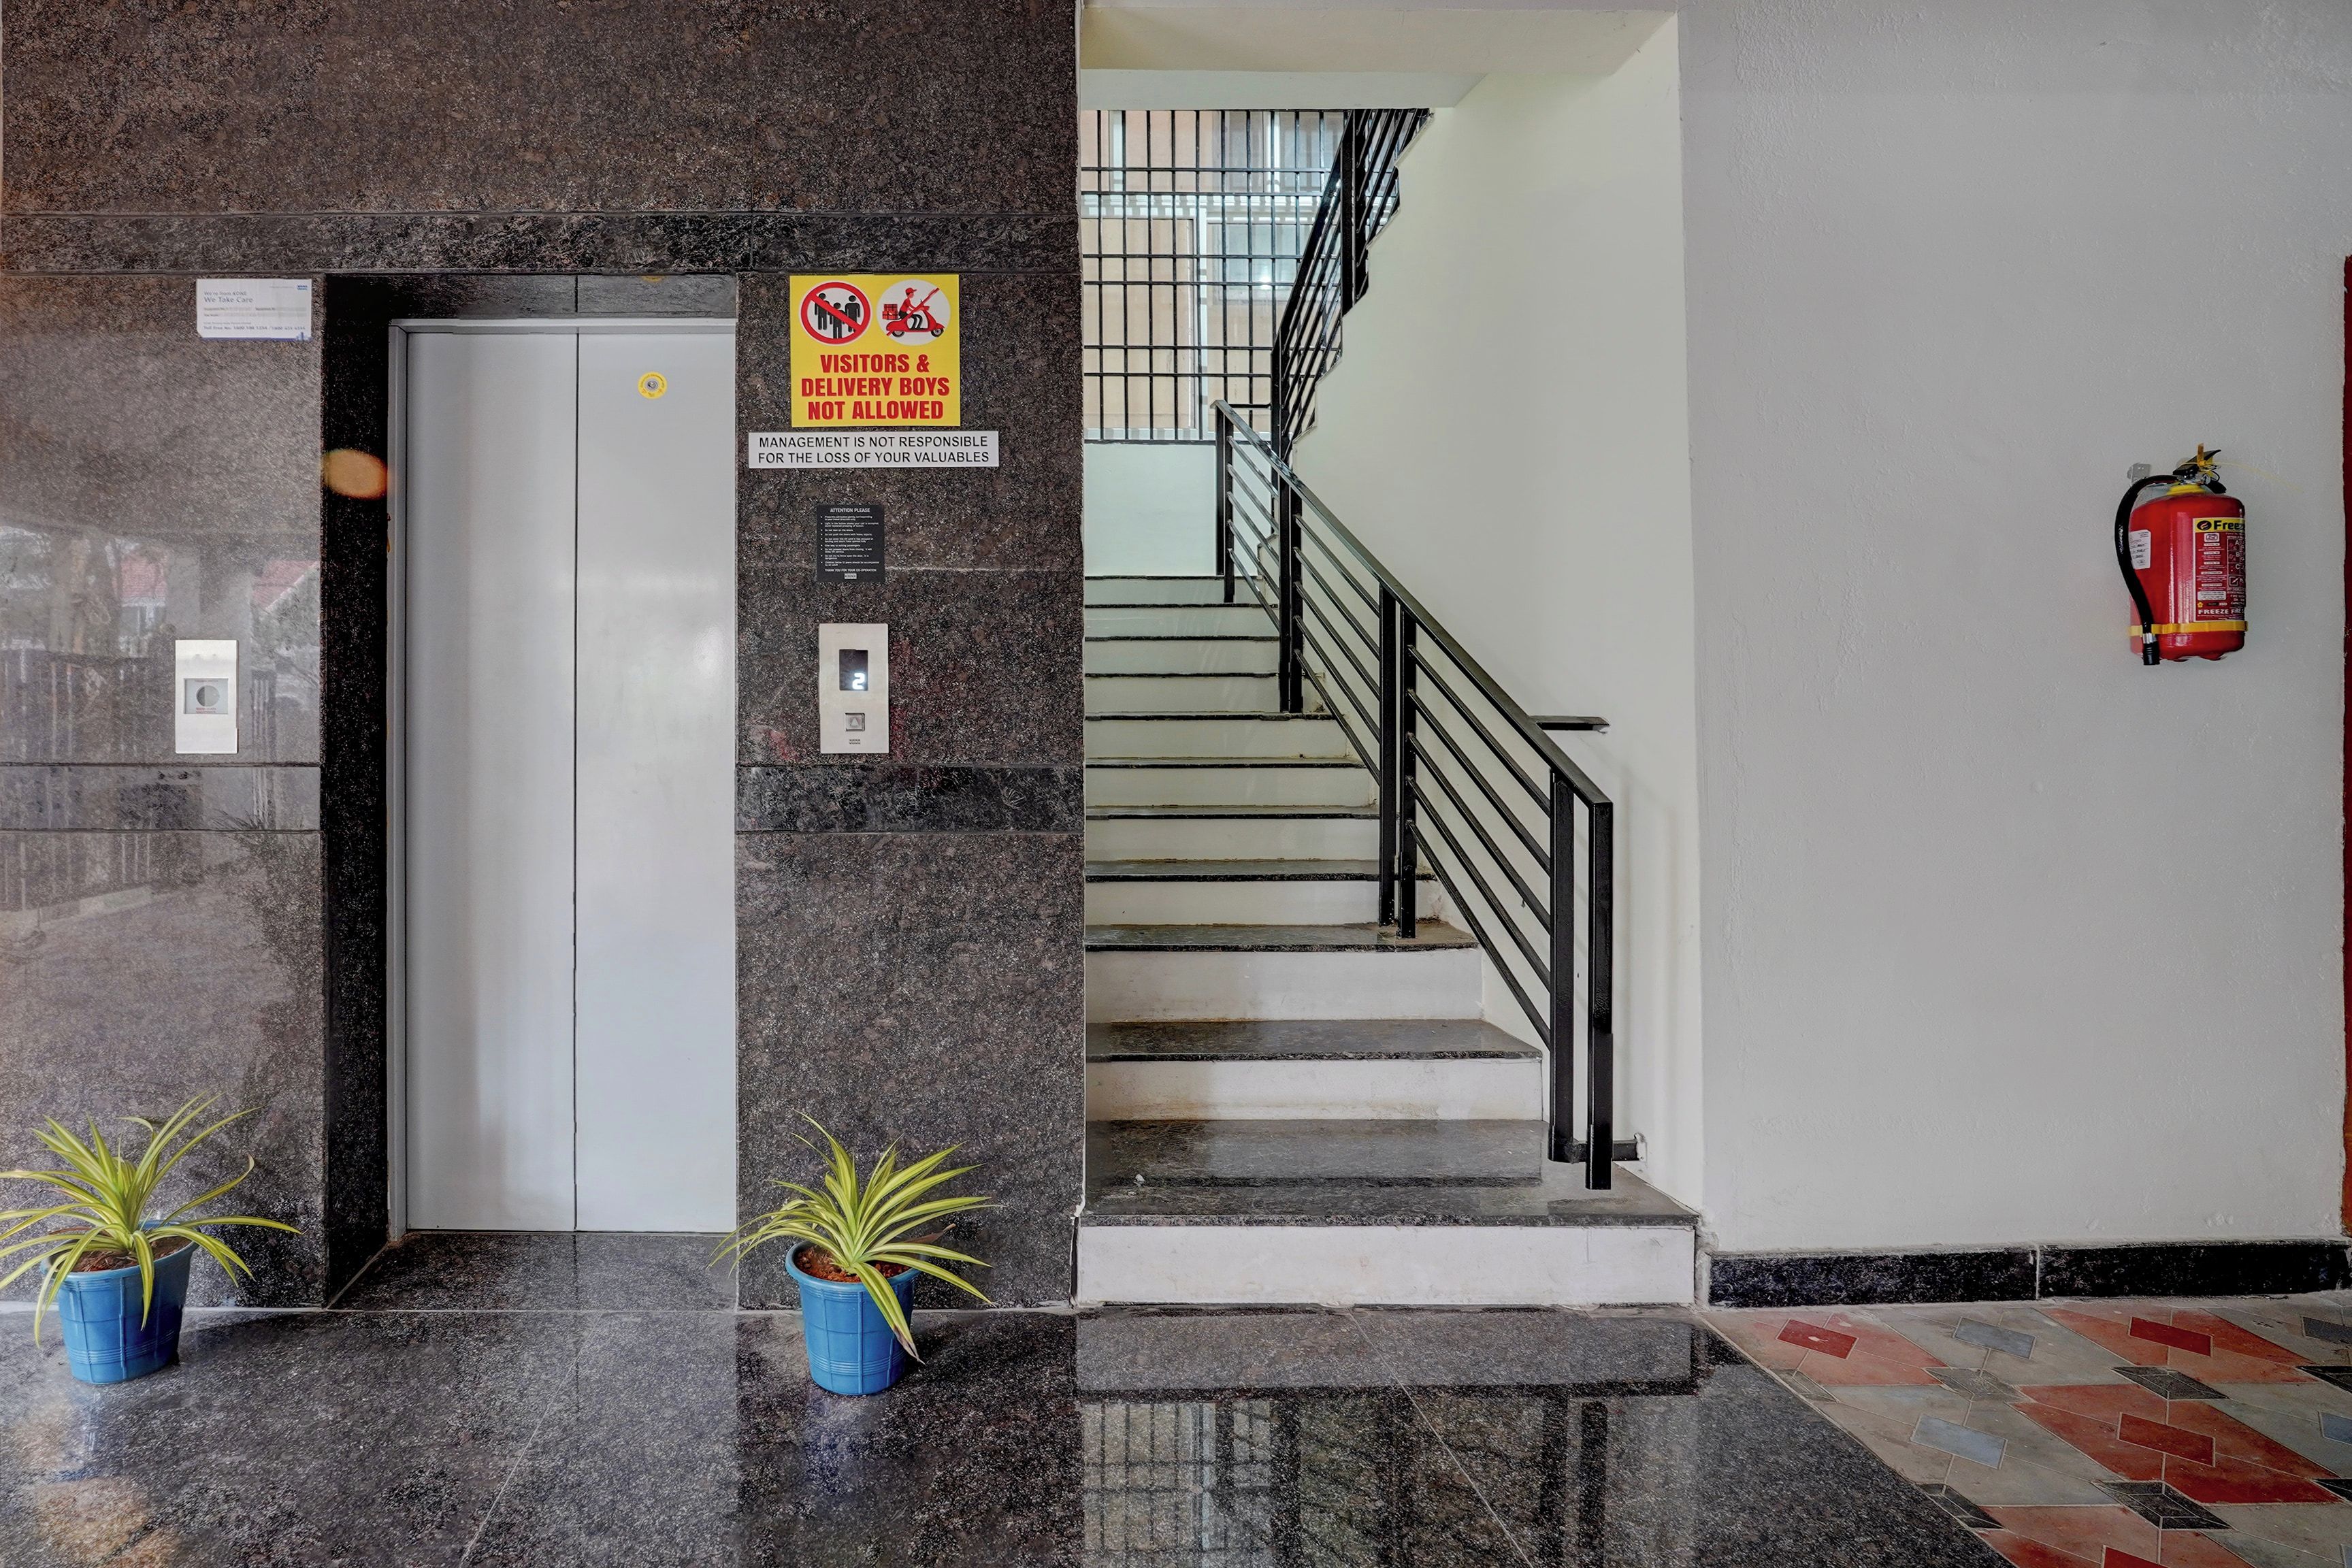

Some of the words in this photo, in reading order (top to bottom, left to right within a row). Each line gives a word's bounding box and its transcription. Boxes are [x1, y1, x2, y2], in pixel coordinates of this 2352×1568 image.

[820, 354, 910, 373] VISITORS
[916, 354, 930, 373] &
[801, 378, 893, 397] DELIVERY
[900, 377, 949, 396] BOYS
[808, 401, 845, 420] NOT
[852, 401, 943, 419] ALLOWED
[759, 436, 850, 447] MANAGEMENT
[853, 436, 865, 447] IS
[869, 436, 894, 447] NOT
[899, 436, 988, 446] RESPONSIBLE
[758, 453, 784, 463] FOR
[788, 453, 813, 463] THE
[817, 453, 851, 463] LOSS
[854, 452, 871, 463] OF
[875, 452, 911, 463] YOUR
[914, 452, 990, 463] VALUABLES
[852, 672, 866, 689] 2
